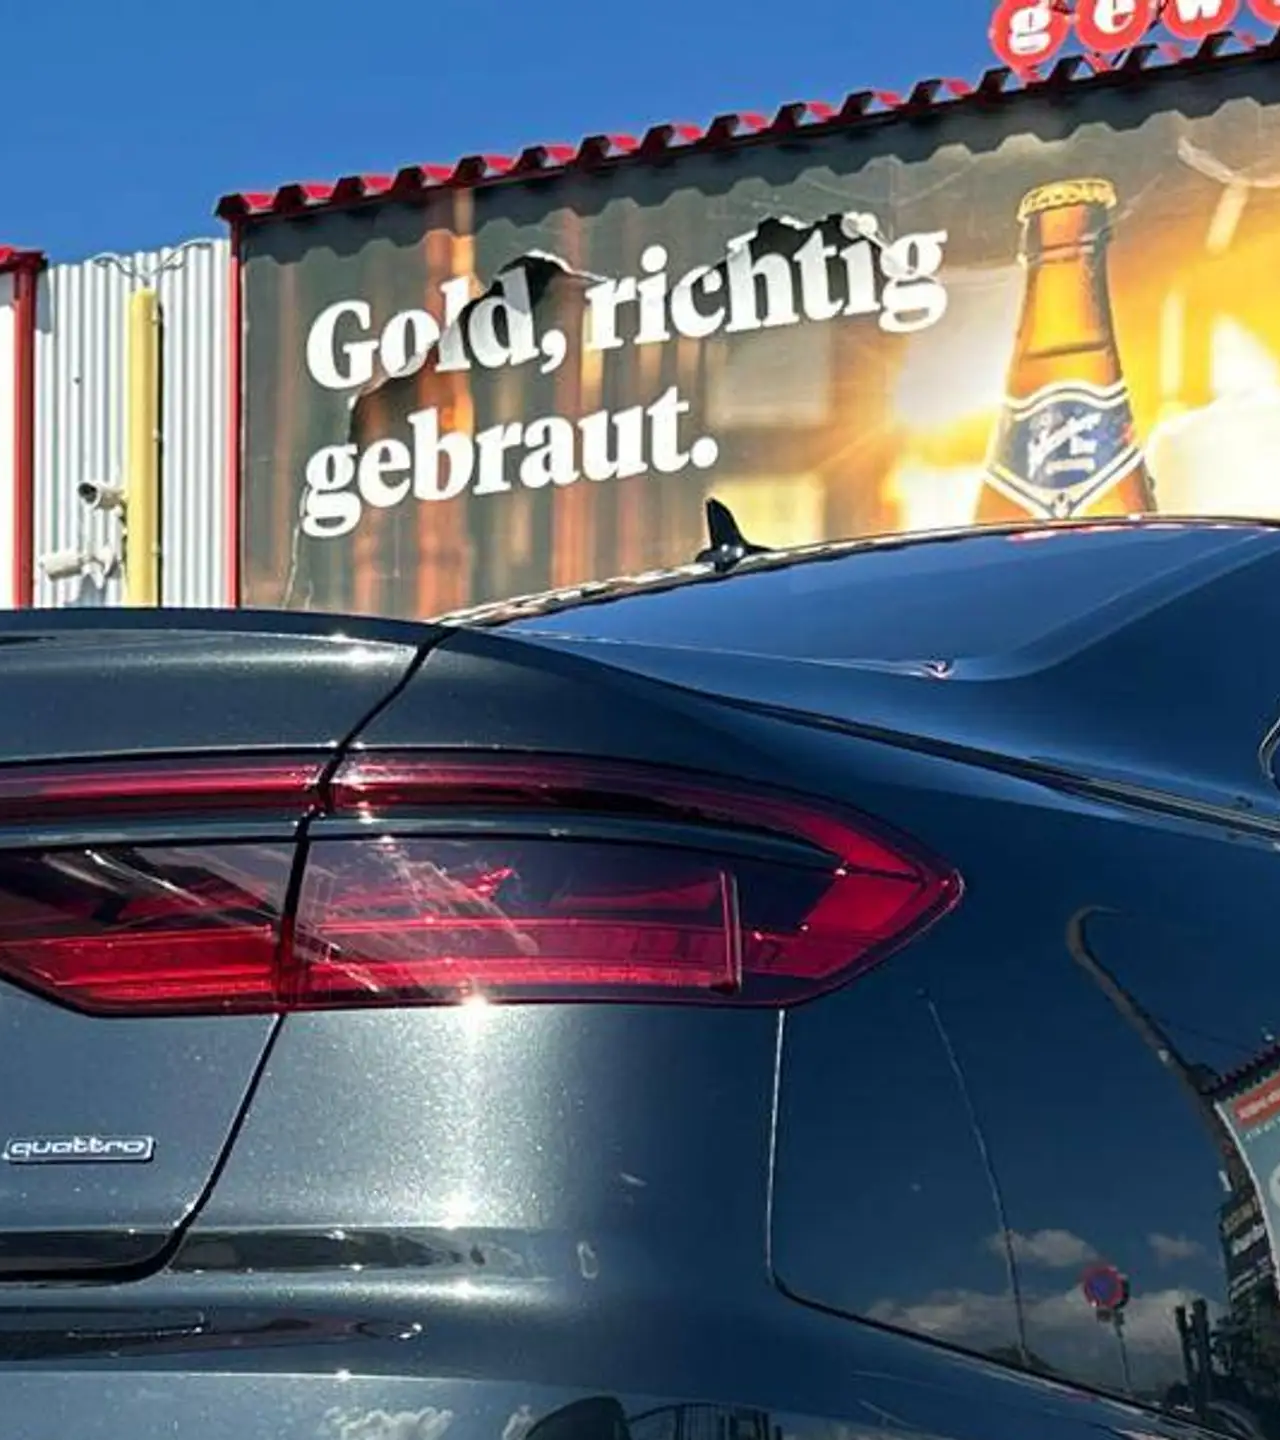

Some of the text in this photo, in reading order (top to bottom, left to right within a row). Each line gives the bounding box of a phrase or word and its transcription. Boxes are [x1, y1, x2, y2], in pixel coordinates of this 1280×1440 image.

[306, 214, 948, 389] Gold, richtig
[301, 386, 719, 538] gebraut.
[10, 1135, 144, 1157] quattro
